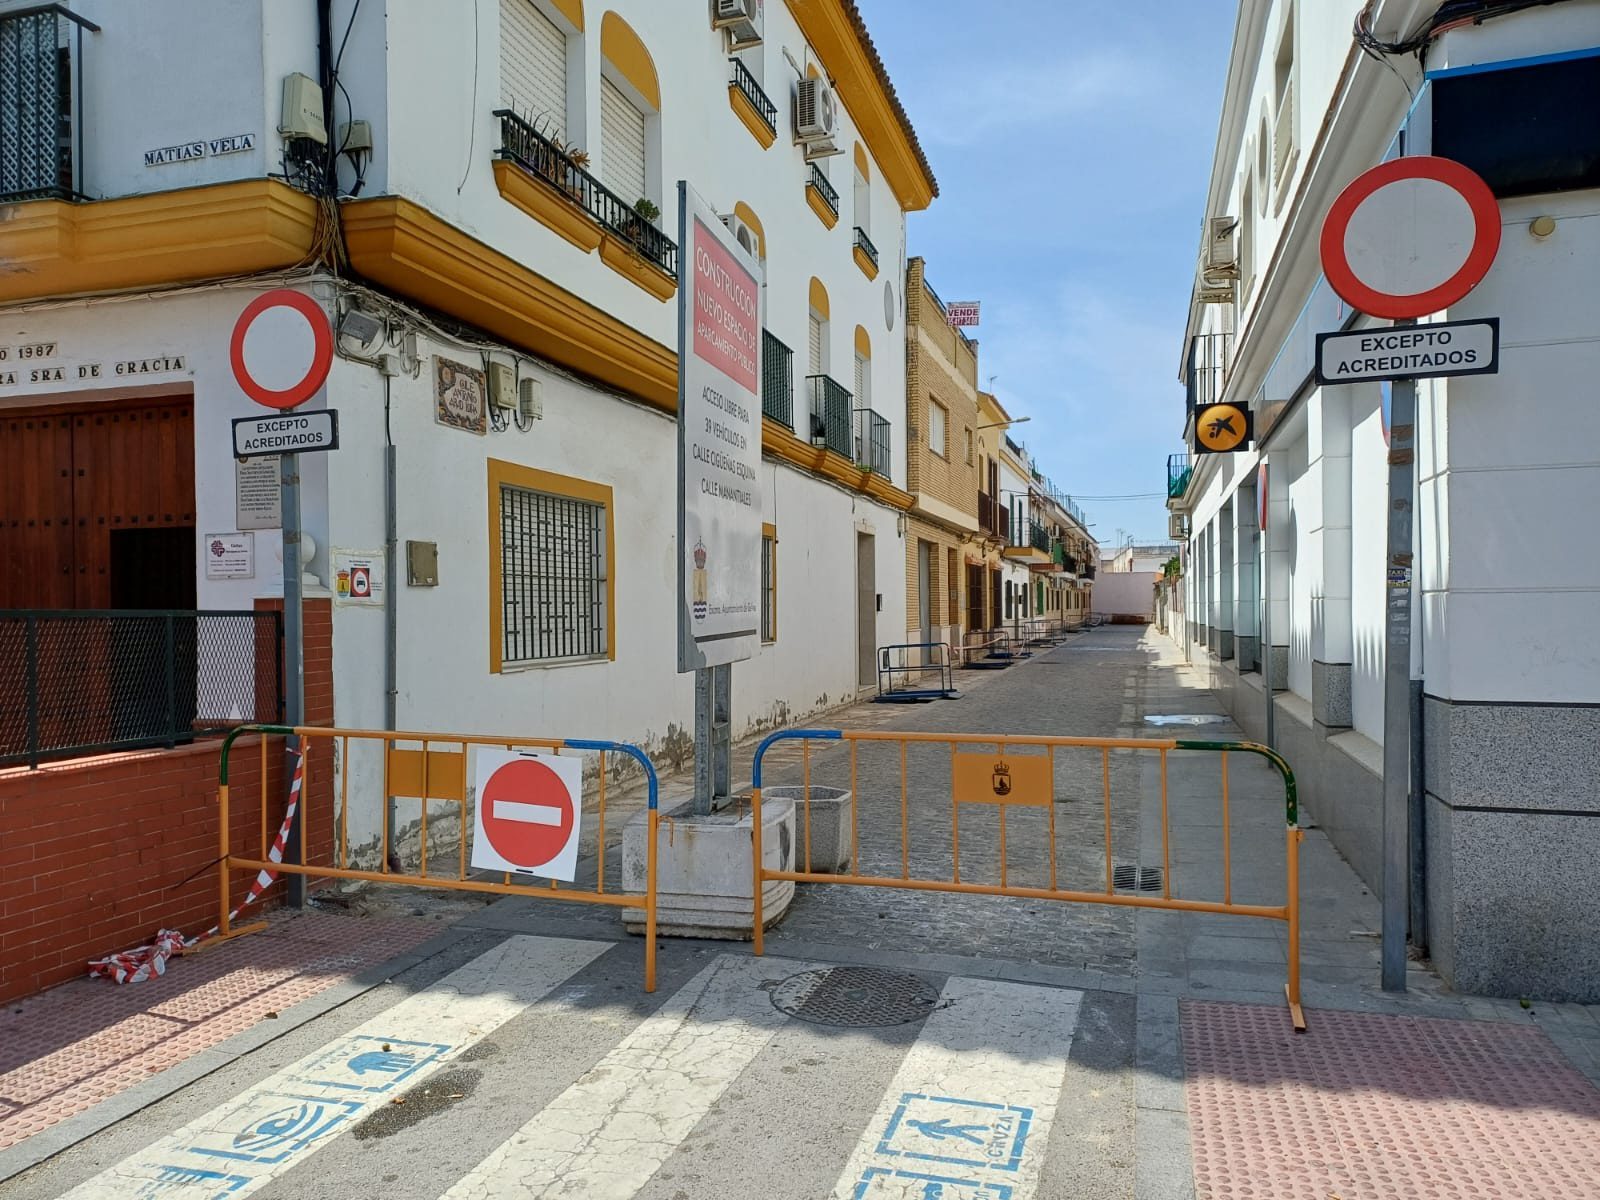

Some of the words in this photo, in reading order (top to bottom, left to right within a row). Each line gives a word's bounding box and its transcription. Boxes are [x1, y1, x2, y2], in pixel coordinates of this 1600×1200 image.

[144, 144, 203, 166] MATIAS
[209, 136, 252, 154] VELA
[696, 246, 756, 321] CONSTRUCCIÓN
[697, 287, 723, 324] NUEVO
[723, 309, 748, 347] ESPACIO
[749, 332, 756, 353] DE
[948, 308, 979, 317] VENDE
[18, 345, 55, 359] 1987
[697, 319, 738, 363] APARCAMIENTO
[1361, 331, 1452, 352] EXCEPTO
[30, 369, 63, 382] SRA
[78, 365, 100, 379] DE
[115, 358, 184, 375] GRACIA
[1337, 349, 1477, 374] ACREDITADOS
[702, 385, 723, 410] ACCESO
[724, 397, 738, 419] LIBRE
[738, 405, 750, 425] PARA
[256, 418, 309, 434] EXCEPTO
[244, 431, 323, 450] ACREDITADOS
[740, 435, 748, 450] EN
[692, 443, 710, 464] CALLE
[701, 477, 718, 497] CALLE
[987, 1114, 1014, 1159] CRUZA
